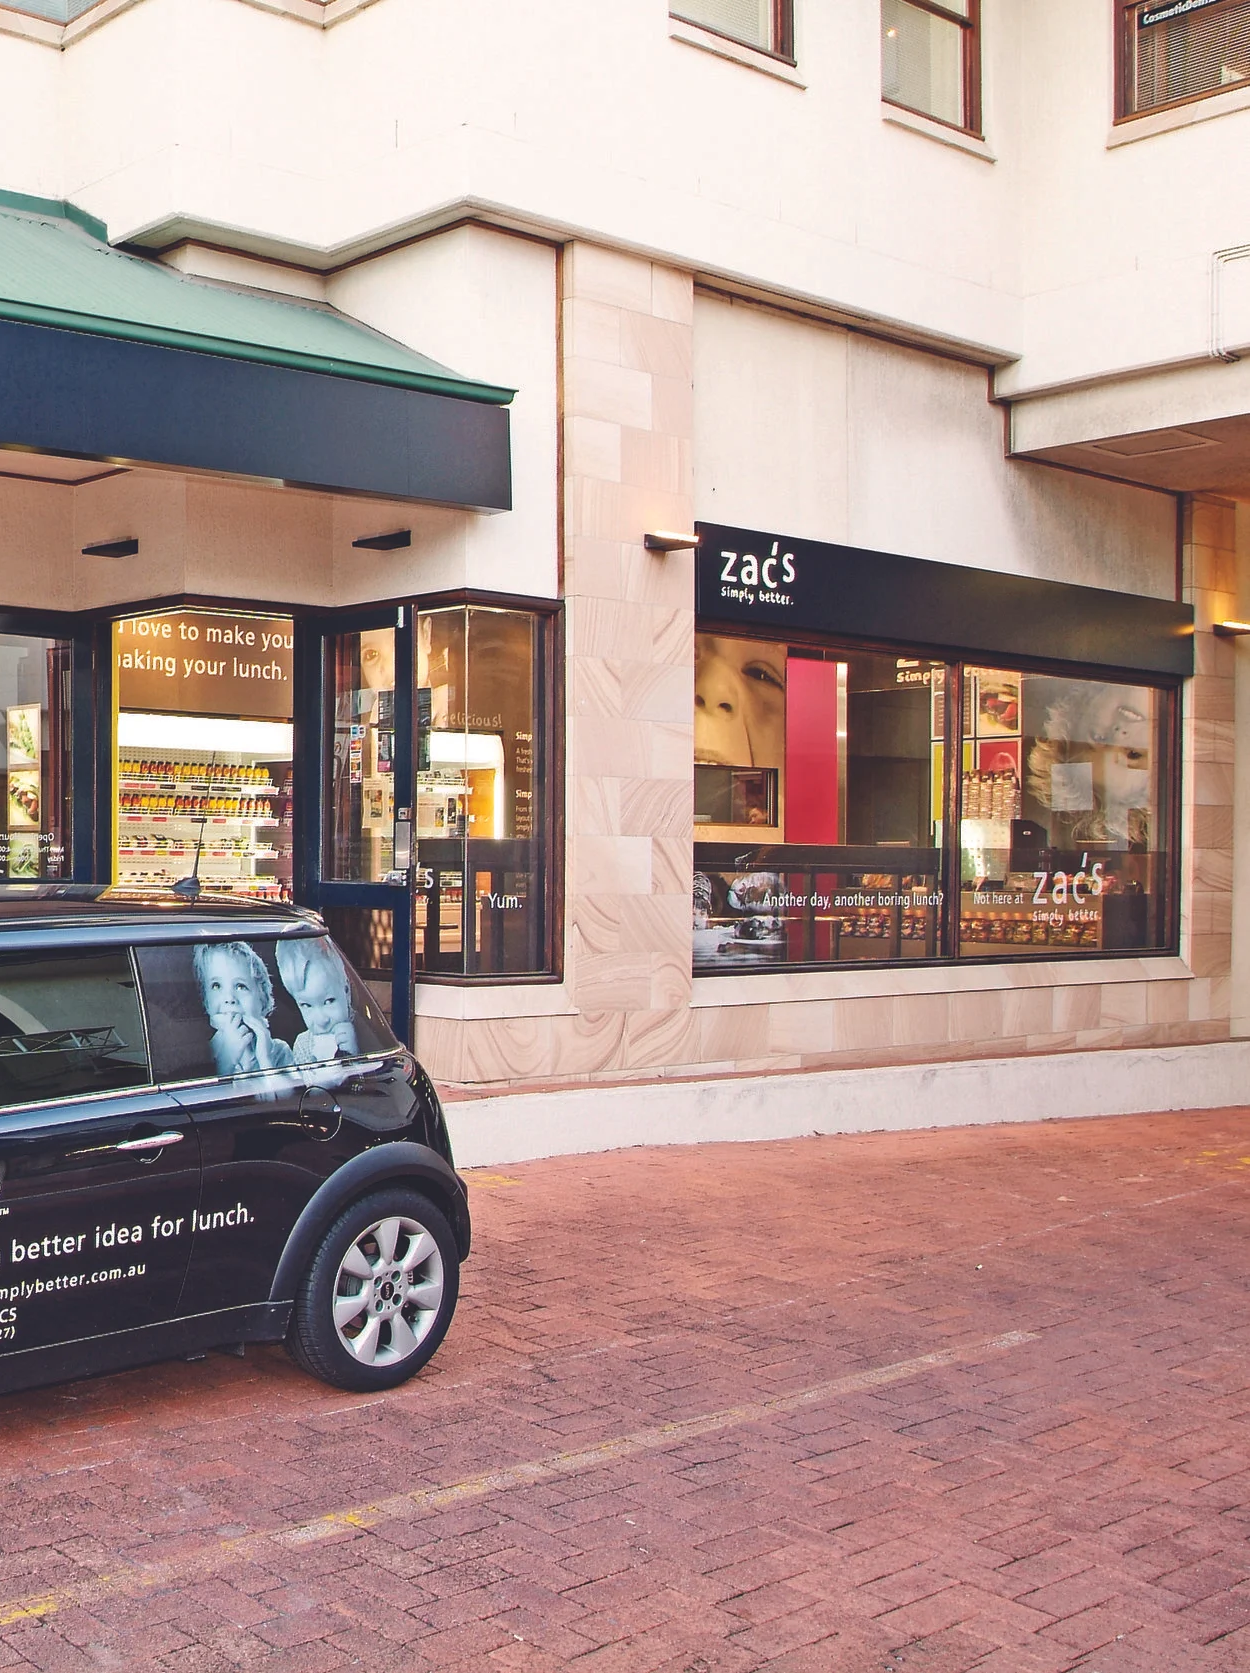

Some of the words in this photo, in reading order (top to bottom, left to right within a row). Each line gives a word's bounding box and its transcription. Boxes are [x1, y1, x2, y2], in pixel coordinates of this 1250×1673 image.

[720, 541, 796, 589] zac's
[720, 586, 754, 605] simply
[759, 590, 794, 605] better.
[131, 618, 172, 638] love
[178, 622, 199, 641] to
[206, 625, 256, 646] make
[183, 658, 226, 678] your
[233, 657, 288, 681] lunch.
[973, 891, 990, 905] Not
[992, 891, 1012, 904] here
[1014, 892, 1024, 904] at
[1032, 852, 1103, 905] zac's
[488, 892, 523, 909] Yum.
[762, 891, 807, 907] Another
[810, 892, 831, 910] day,
[834, 892, 874, 907] another
[877, 892, 910, 909] boring
[912, 892, 944, 906] lunch?
[1032, 908, 1064, 926] simply
[1068, 909, 1102, 922] better.
[11, 1233, 87, 1263] better
[95, 1222, 143, 1248] idea
[151, 1215, 185, 1239] for
[191, 1202, 255, 1232] lunch.
